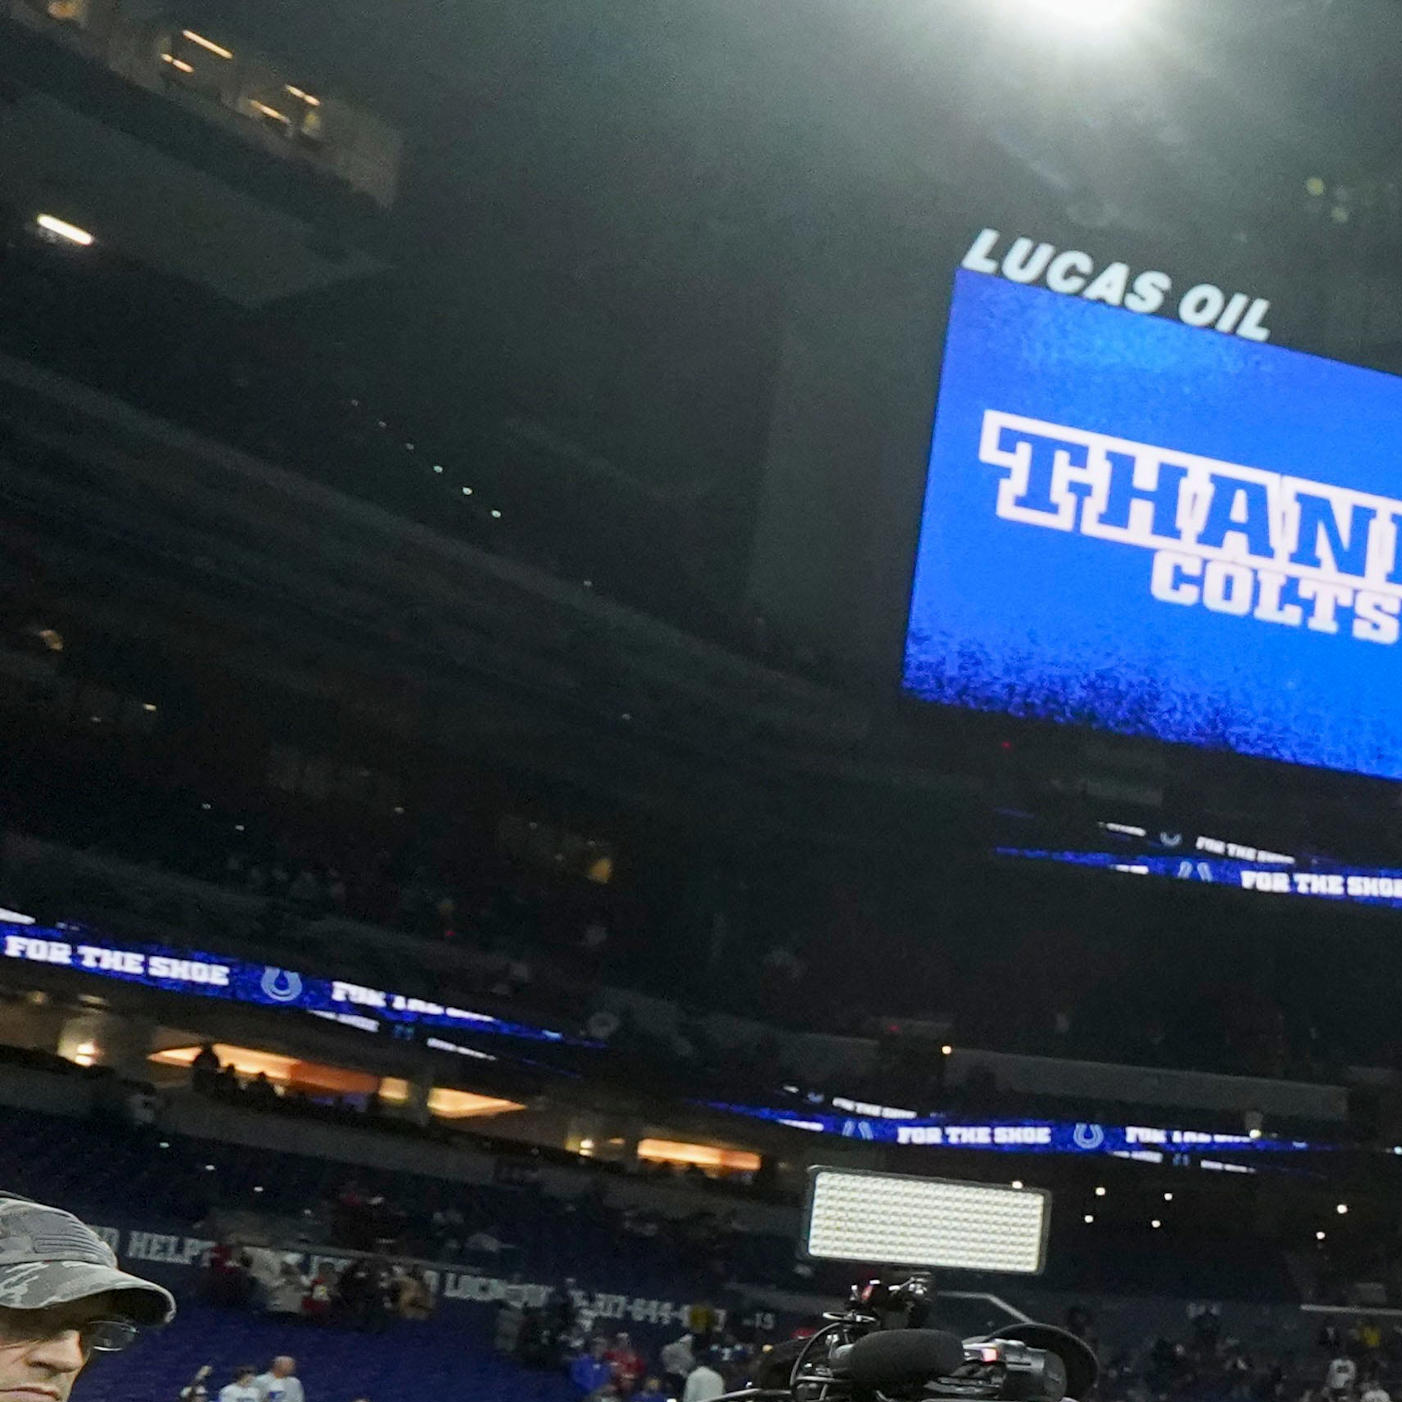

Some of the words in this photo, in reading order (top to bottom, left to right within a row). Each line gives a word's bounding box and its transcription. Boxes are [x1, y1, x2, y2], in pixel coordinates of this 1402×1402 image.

[961, 228, 1172, 313] LUCAS
[1179, 283, 1271, 342] OIL
[1151, 550, 1400, 643] COLTS
[1241, 870, 1291, 893] FOR
[1293, 873, 1345, 895] THE
[4, 935, 72, 965] FOR
[77, 945, 145, 975] THE
[148, 956, 230, 986] SHOE
[897, 1126, 943, 1144] FOR
[945, 1126, 992, 1144] THE
[994, 1126, 1051, 1144] SHOE
